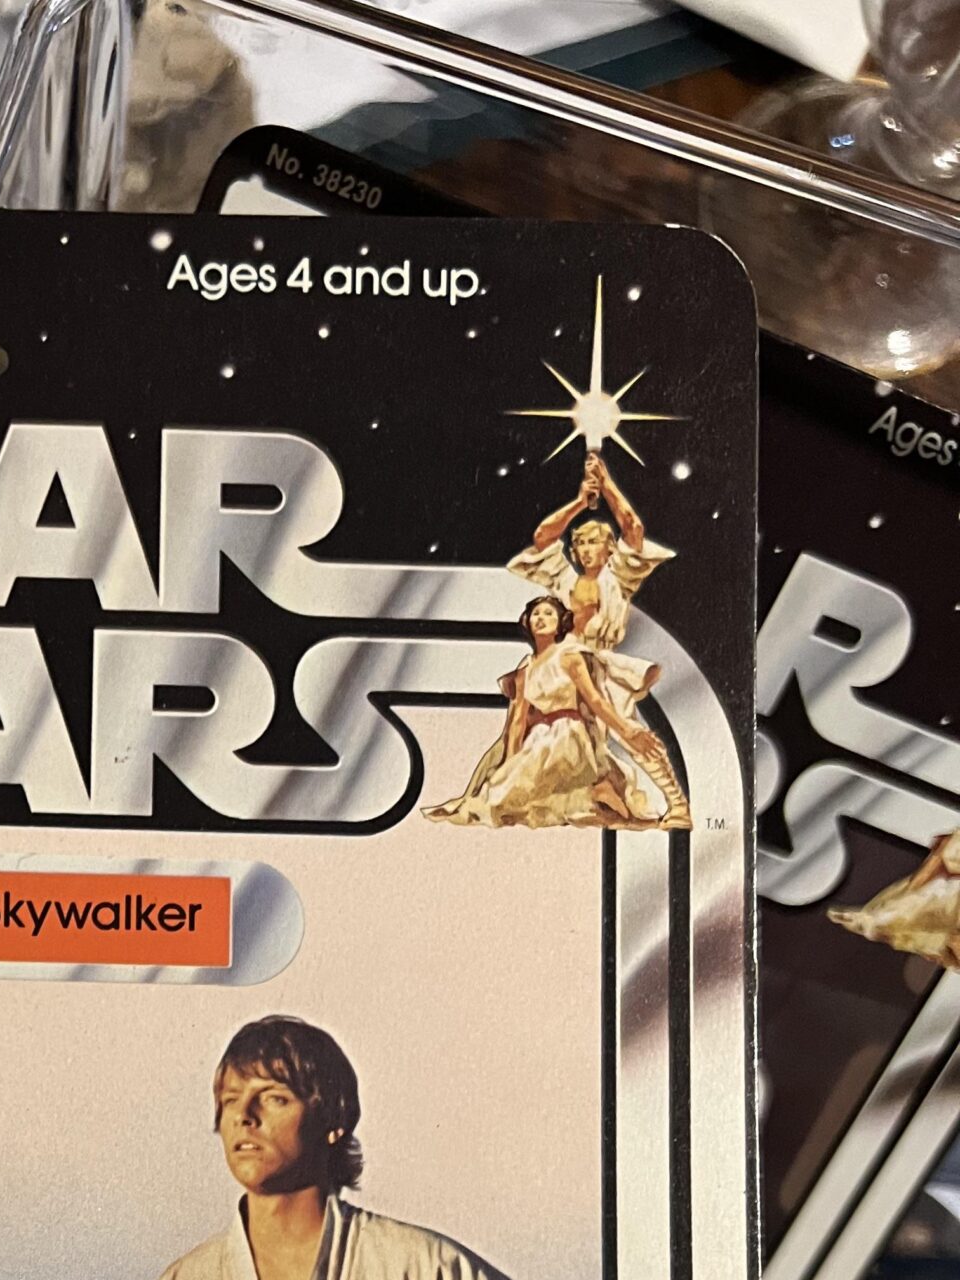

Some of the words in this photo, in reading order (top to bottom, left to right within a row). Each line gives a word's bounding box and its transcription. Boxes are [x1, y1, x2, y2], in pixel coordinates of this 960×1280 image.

[265, 143, 303, 179] No.
[312, 164, 383, 209] 38230
[167, 254, 277, 300] Ages
[286, 256, 313, 293] 4
[323, 259, 410, 296] and
[868, 405, 958, 466] Ages
